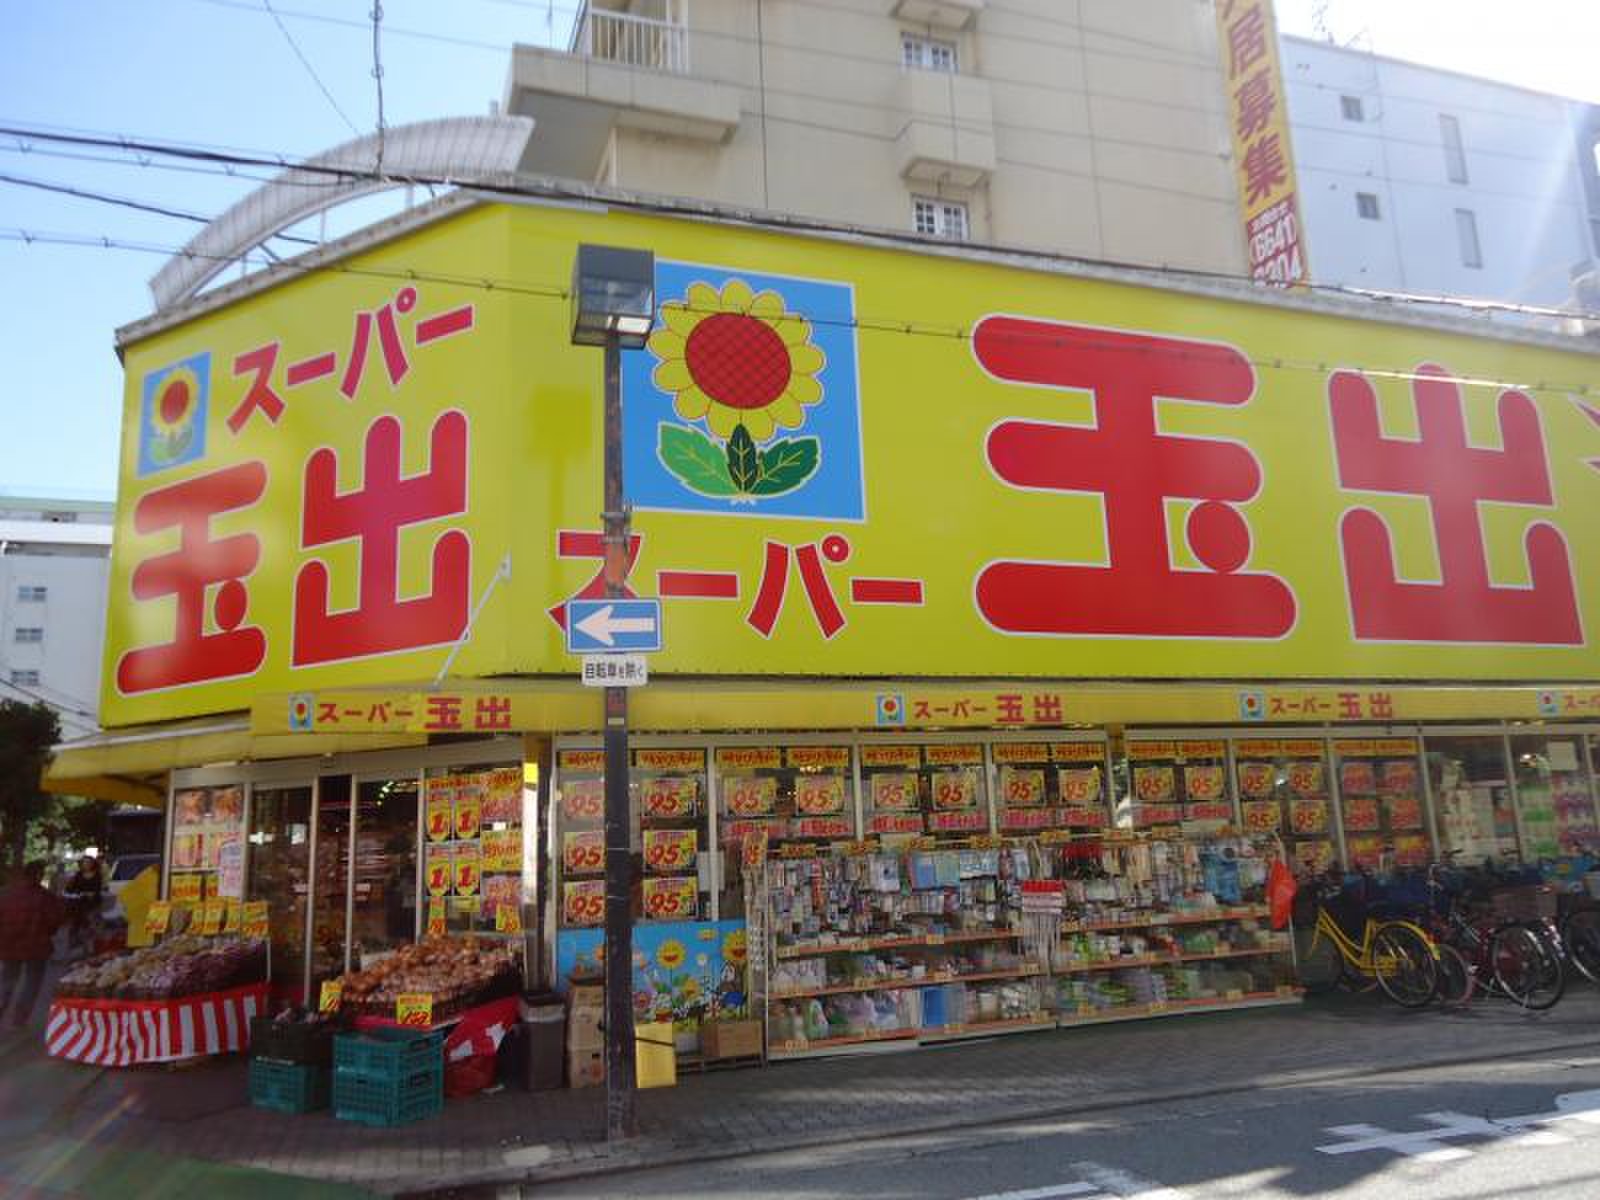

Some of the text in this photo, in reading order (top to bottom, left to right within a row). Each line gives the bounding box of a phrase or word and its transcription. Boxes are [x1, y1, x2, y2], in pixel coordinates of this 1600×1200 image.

[1222, 0, 1287, 206] 居募集
[227, 287, 475, 435] スーパー
[116, 408, 471, 695] 玉出
[972, 313, 1584, 646] 玉出
[548, 528, 924, 639] スーパー
